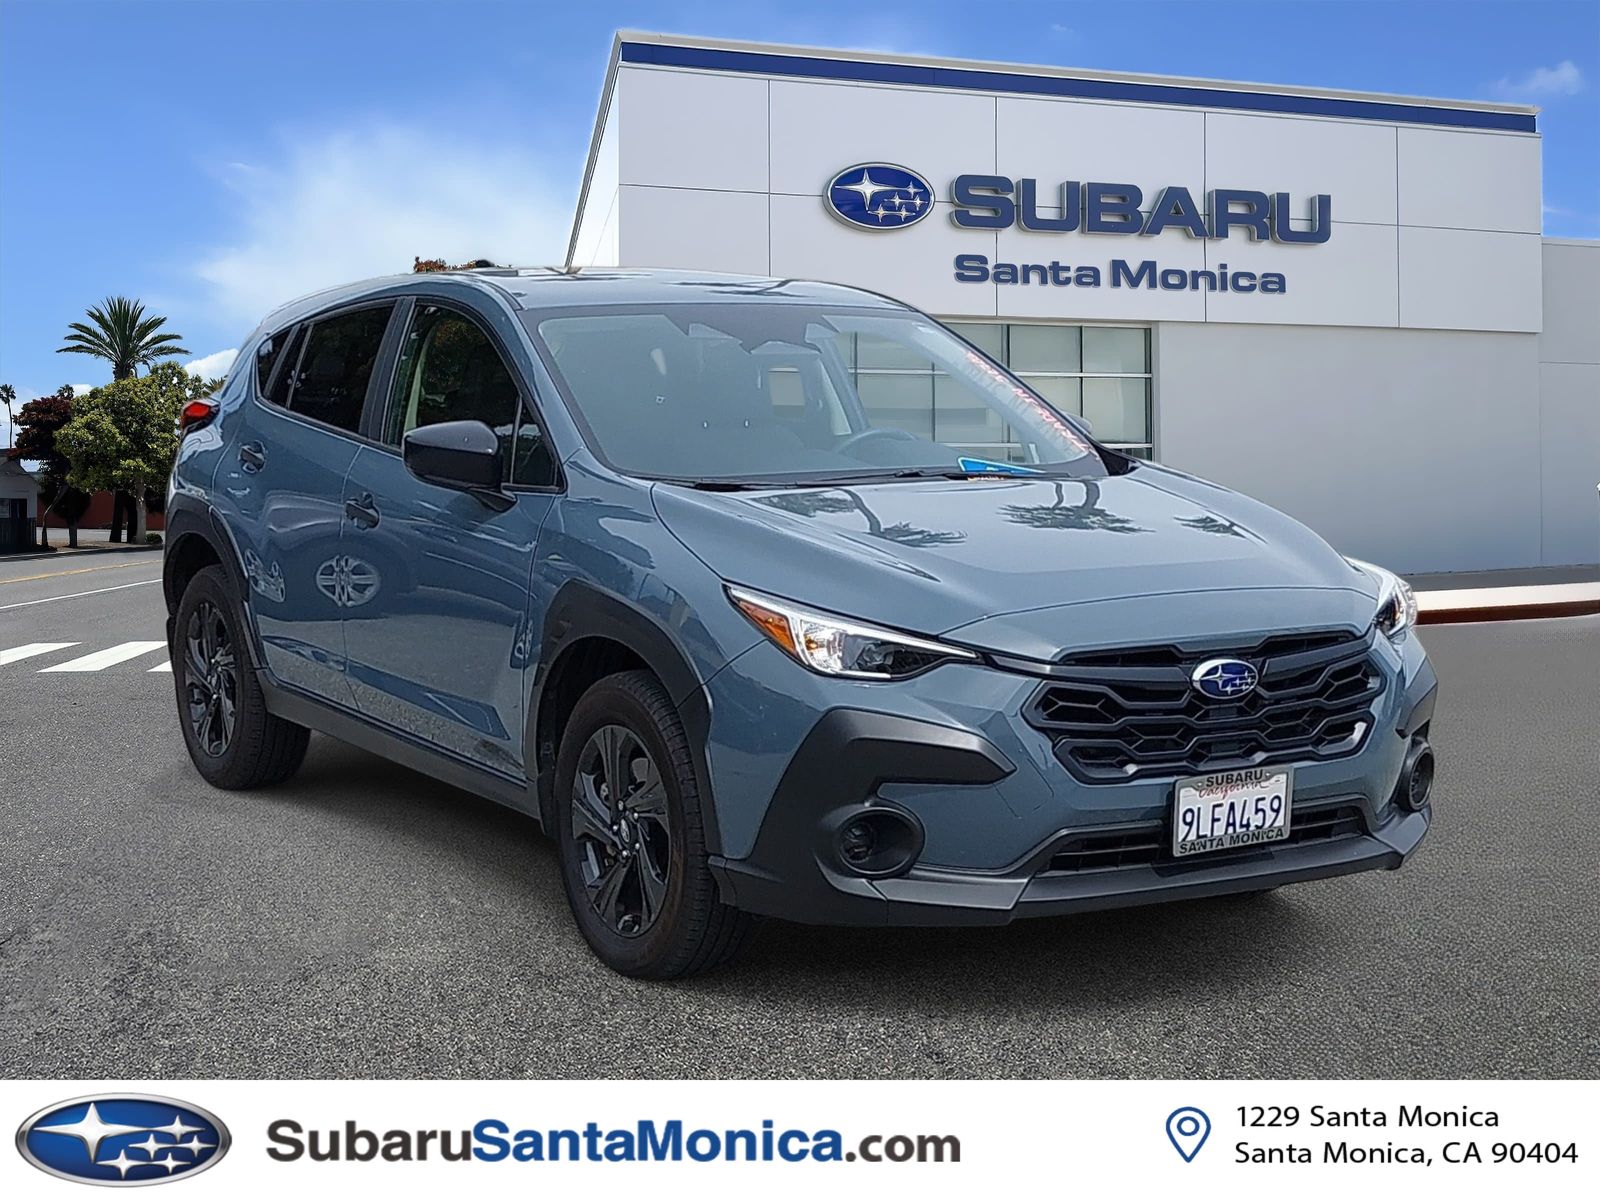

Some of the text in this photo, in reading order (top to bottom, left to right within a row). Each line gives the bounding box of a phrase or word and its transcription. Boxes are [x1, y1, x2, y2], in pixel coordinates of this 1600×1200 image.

[950, 174, 1332, 244] SUBARU
[954, 254, 1287, 294] Santa Monica
[1206, 769, 1264, 788] SUBARU
[1181, 795, 1282, 843] 9LFA459
[1179, 828, 1284, 855] SANTA MONICA
